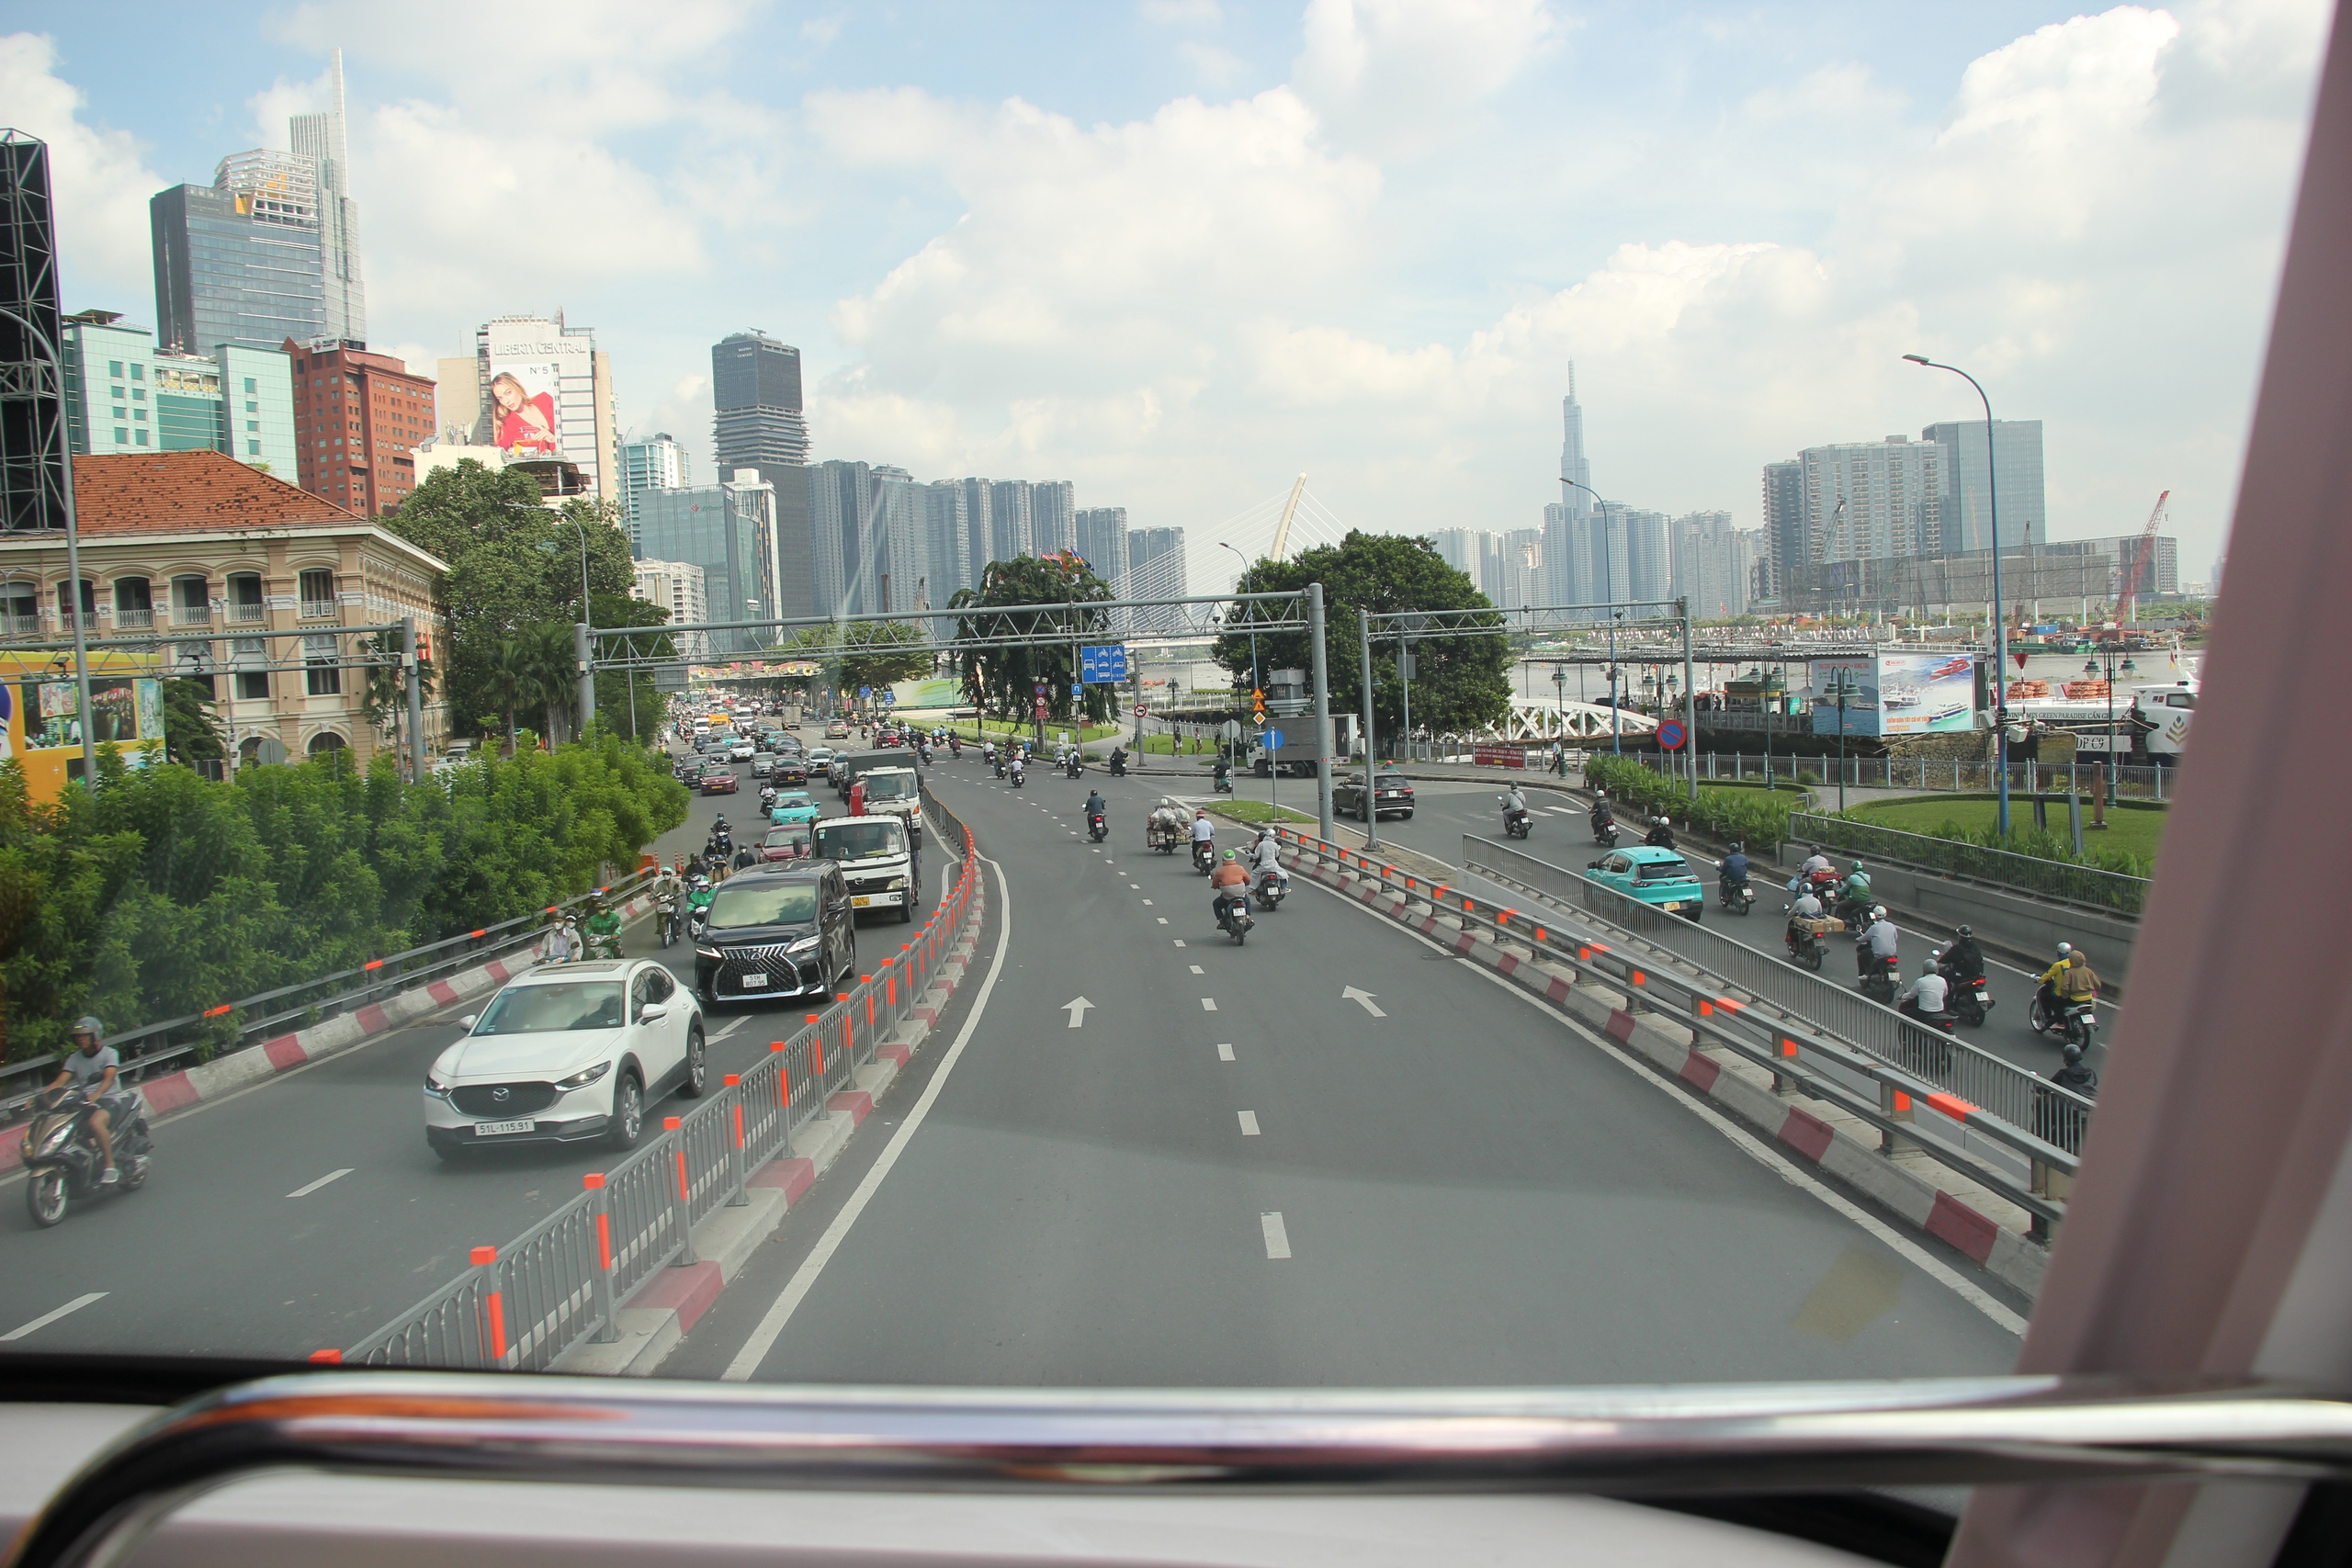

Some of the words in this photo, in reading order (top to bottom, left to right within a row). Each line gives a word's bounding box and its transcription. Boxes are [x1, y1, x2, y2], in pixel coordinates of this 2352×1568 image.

[495, 343, 535, 356] LIBERTY
[537, 342, 586, 355] CENTRAL
[2092, 737, 2104, 749] C9
[480, 1122, 529, 1134] 51L-115.91
